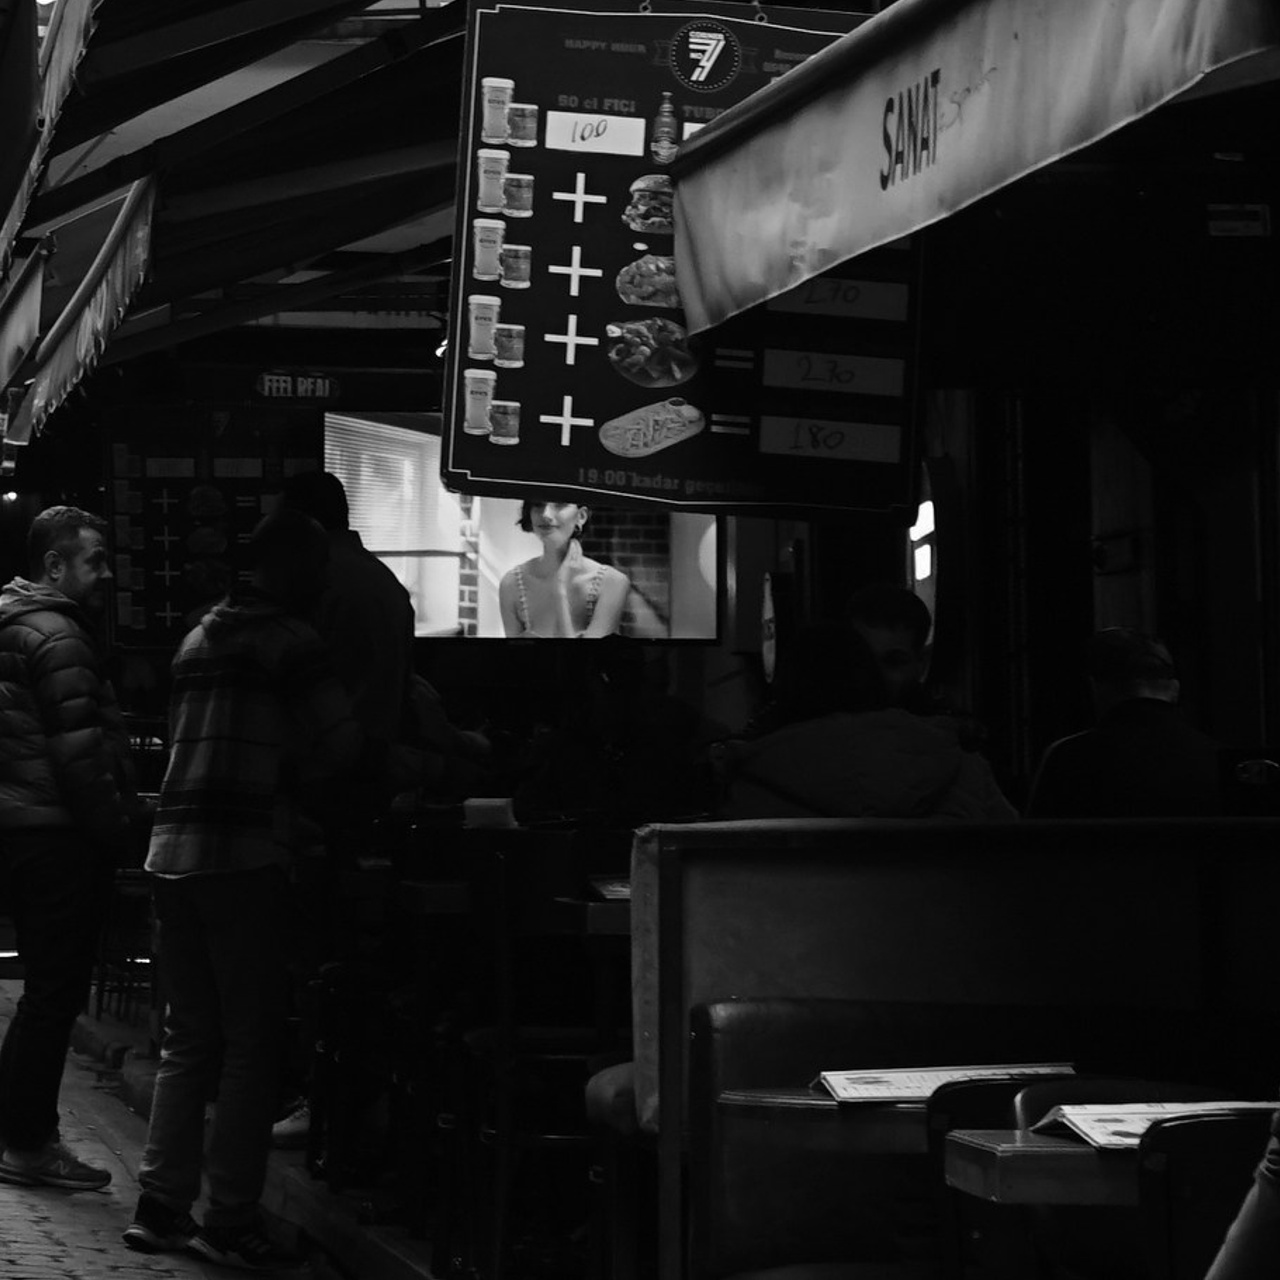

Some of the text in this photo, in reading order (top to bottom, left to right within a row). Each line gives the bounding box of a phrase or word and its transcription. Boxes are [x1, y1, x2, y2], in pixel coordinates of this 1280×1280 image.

[571, 118, 608, 144] 100
[880, 67, 942, 192] SANAT
[797, 355, 855, 384] 270
[789, 422, 845, 450] 180
